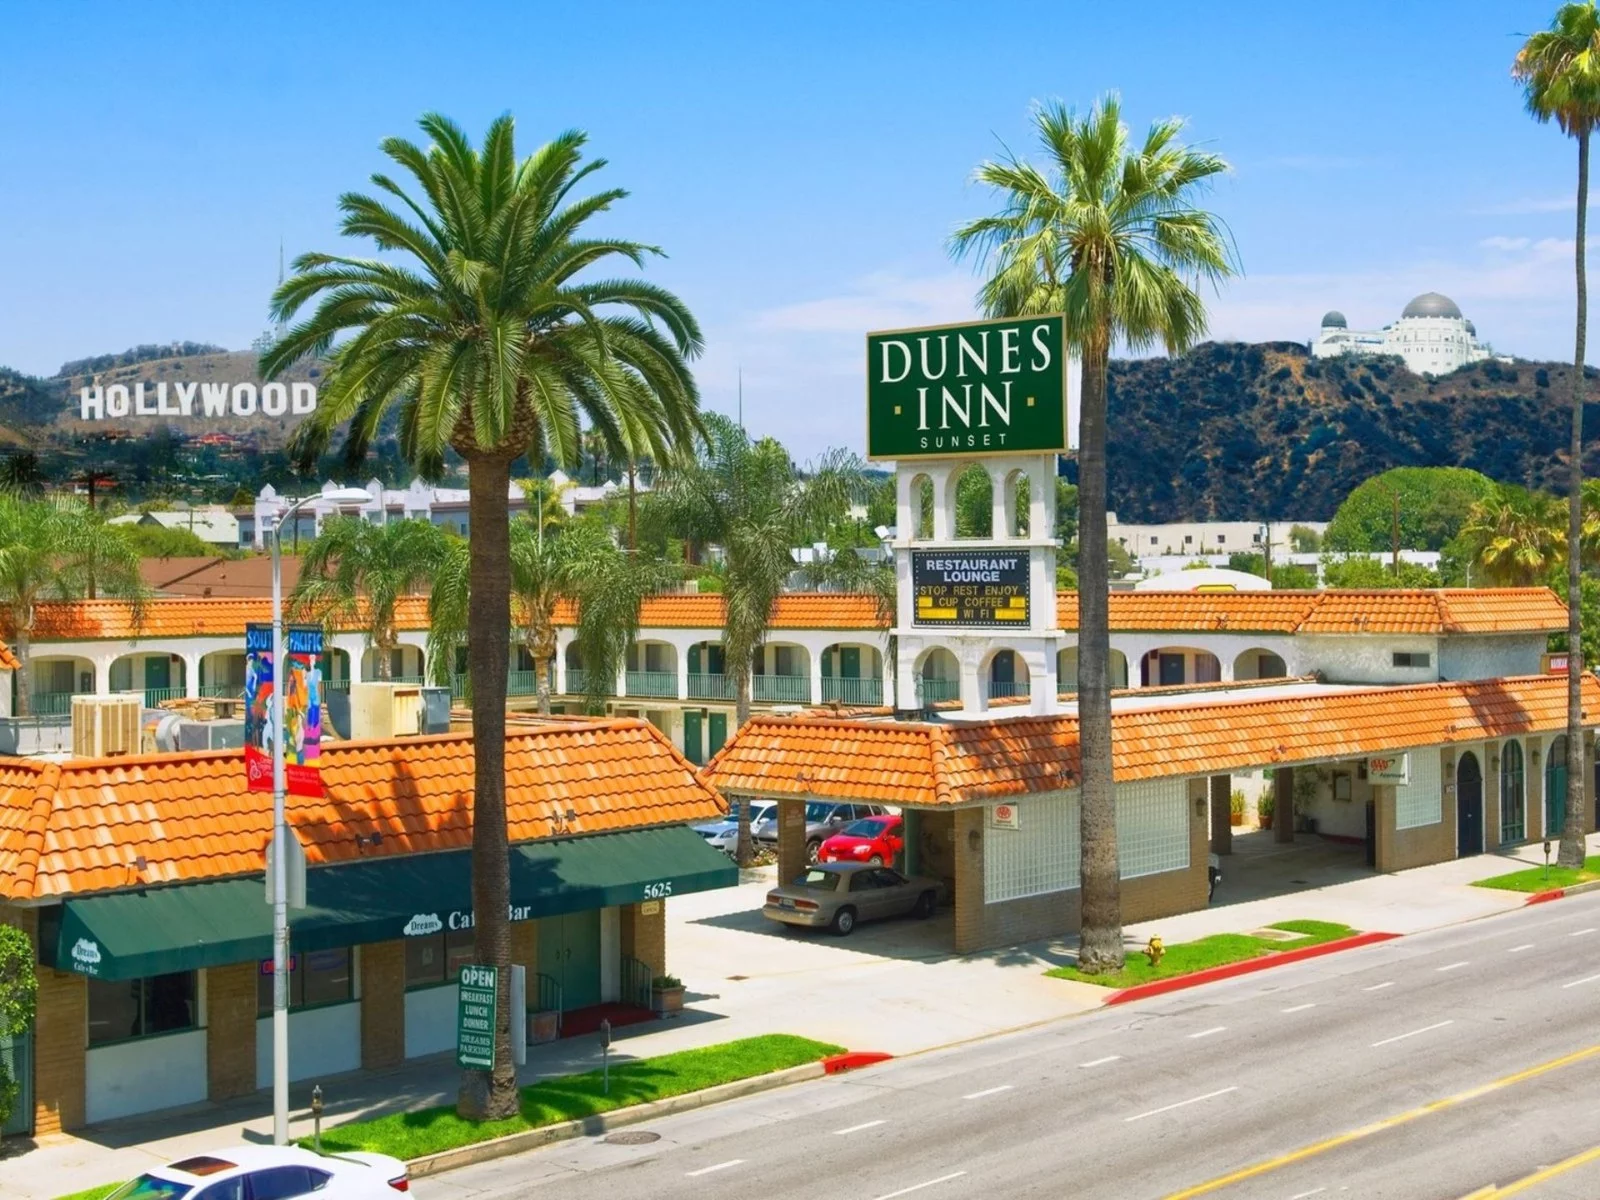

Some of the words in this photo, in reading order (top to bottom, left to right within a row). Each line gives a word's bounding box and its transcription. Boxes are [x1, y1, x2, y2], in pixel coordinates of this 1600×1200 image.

[879, 324, 1052, 384] DUNES
[80, 382, 317, 420] HOLLYWOOD
[916, 381, 1014, 431] INN
[920, 433, 1007, 449] SUNSET
[926, 559, 1018, 571] RESTAURANT
[943, 571, 1001, 582] LOUNGE
[920, 586, 947, 596] STOP
[953, 586, 979, 595] REST
[985, 586, 1019, 595] ENJOY
[939, 597, 958, 607] CUP
[965, 597, 1004, 607] COFFEE
[963, 609, 974, 619] WI
[980, 609, 990, 619] FI
[247, 630, 273, 649] SOUT
[289, 631, 322, 652] PACIFIC
[644, 882, 671, 899] 5625
[411, 920, 438, 931] Dreams
[448, 911, 476, 930] Caf
[76, 944, 98, 959] Dreams
[461, 968, 494, 988] OPEN
[461, 991, 493, 1005] BREAKFAST
[465, 1005, 488, 1017] LUNCH
[463, 1017, 489, 1031] DINNER
[461, 1034, 491, 1046] DREAMS
[459, 1044, 491, 1056] PARKING
